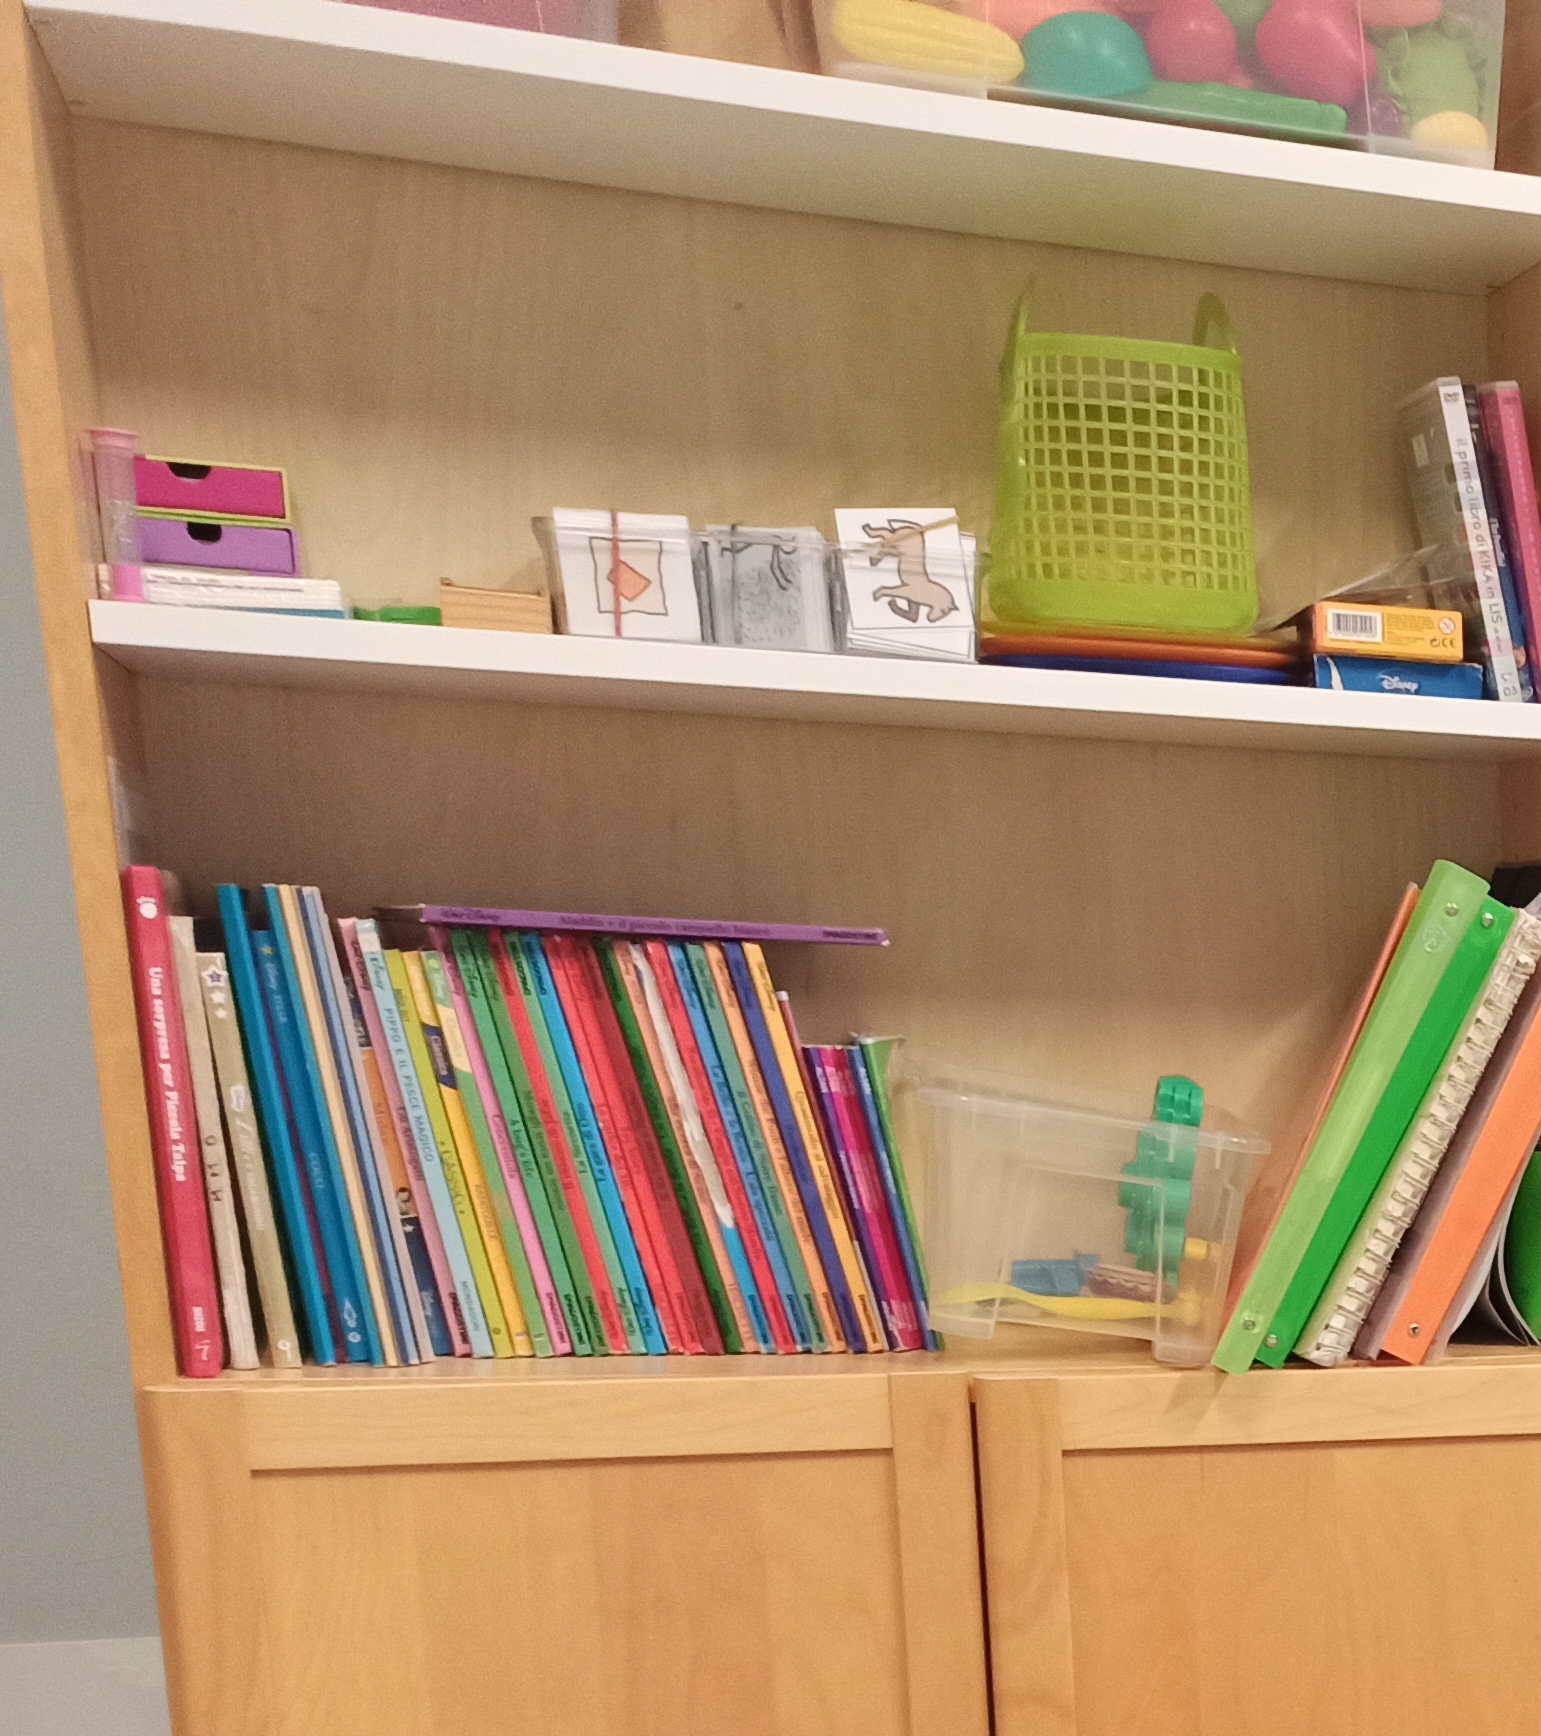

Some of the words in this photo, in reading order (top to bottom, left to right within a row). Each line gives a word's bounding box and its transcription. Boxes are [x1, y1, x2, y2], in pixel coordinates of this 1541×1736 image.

[147, 965, 165, 996] Una
[149, 997, 171, 1060] sorpresa
[157, 1061, 175, 1089] per
[382, 1006, 402, 1044] PIPPO
[401, 1073, 421, 1111] PESCE
[412, 1113, 436, 1163] MAGICO
[164, 1089, 182, 1140] Piccola
[167, 1143, 188, 1182] Talpa
